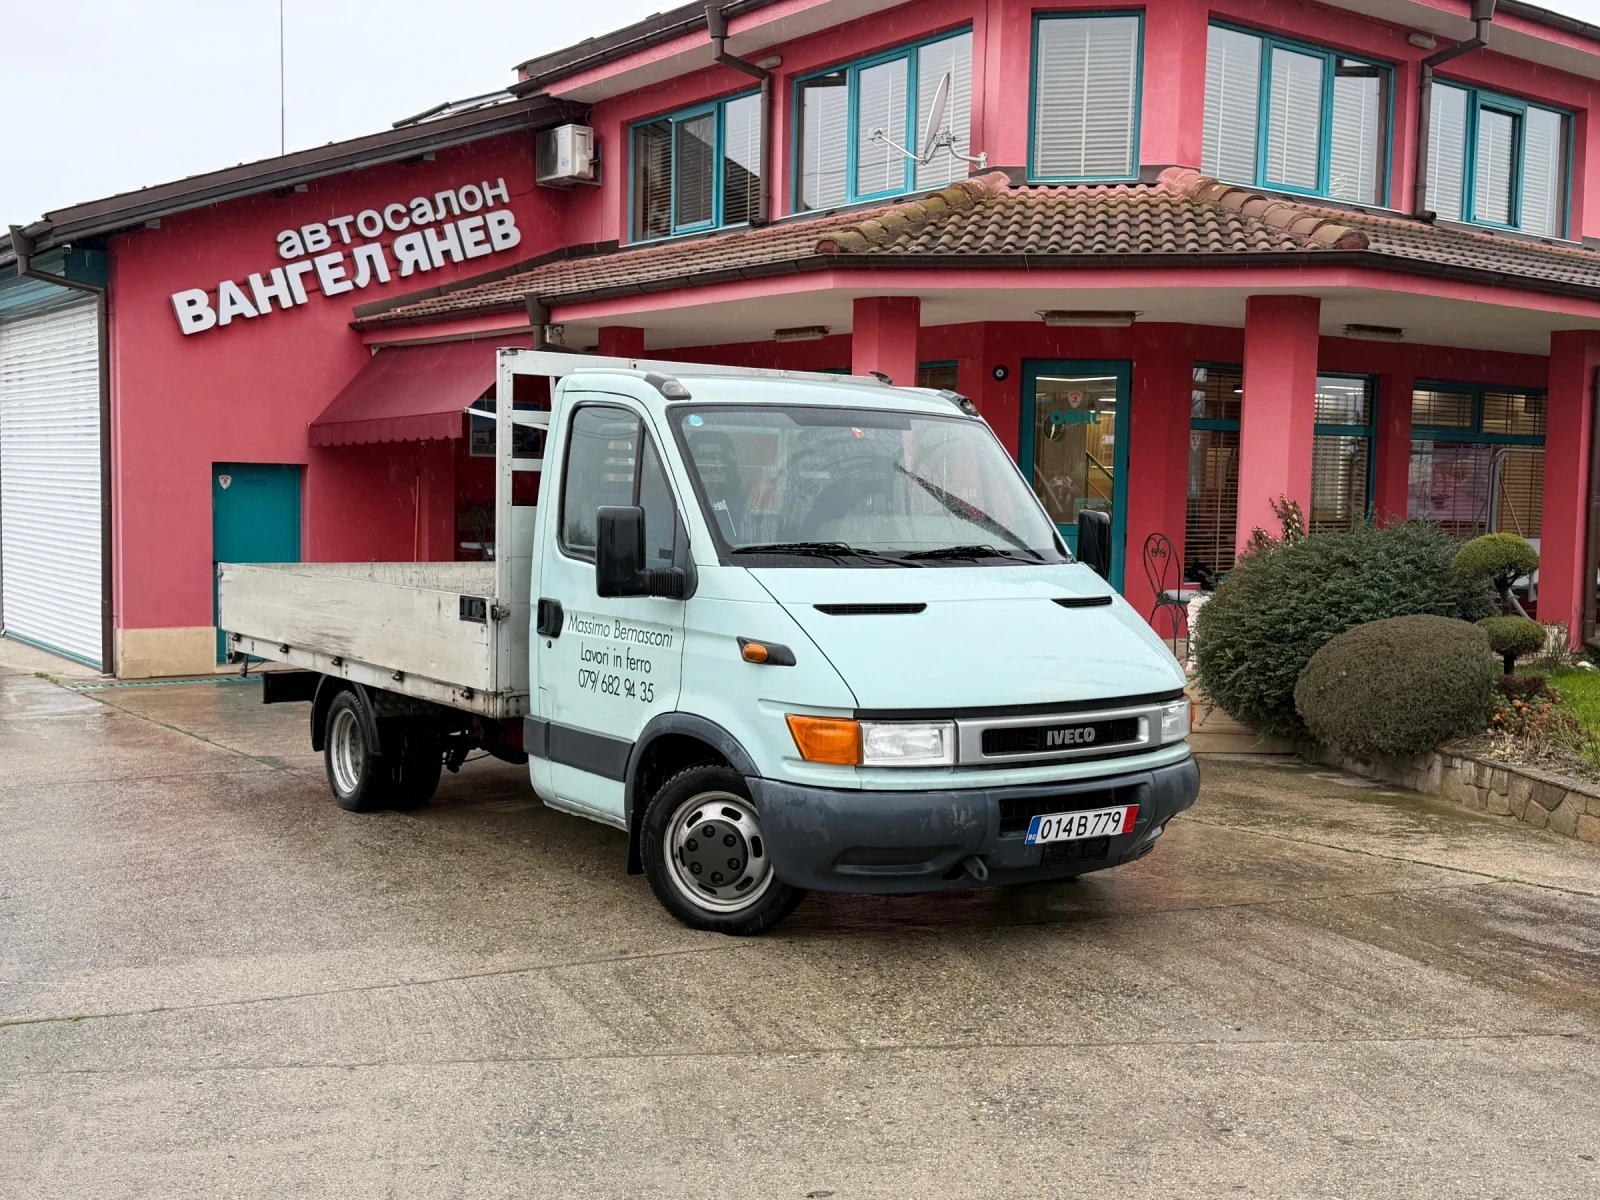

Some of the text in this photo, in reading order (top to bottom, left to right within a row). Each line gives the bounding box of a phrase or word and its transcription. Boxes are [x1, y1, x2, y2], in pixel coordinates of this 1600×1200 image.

[278, 178, 509, 258] автосалон
[171, 210, 521, 335] ВАНГЕЛ ЯНЕВ
[568, 613, 673, 648] Massimo Bernasconi
[580, 642, 652, 674] Lavori in ferro
[578, 669, 654, 702] 079/ 682 94 35
[1046, 727, 1096, 746] IVECO
